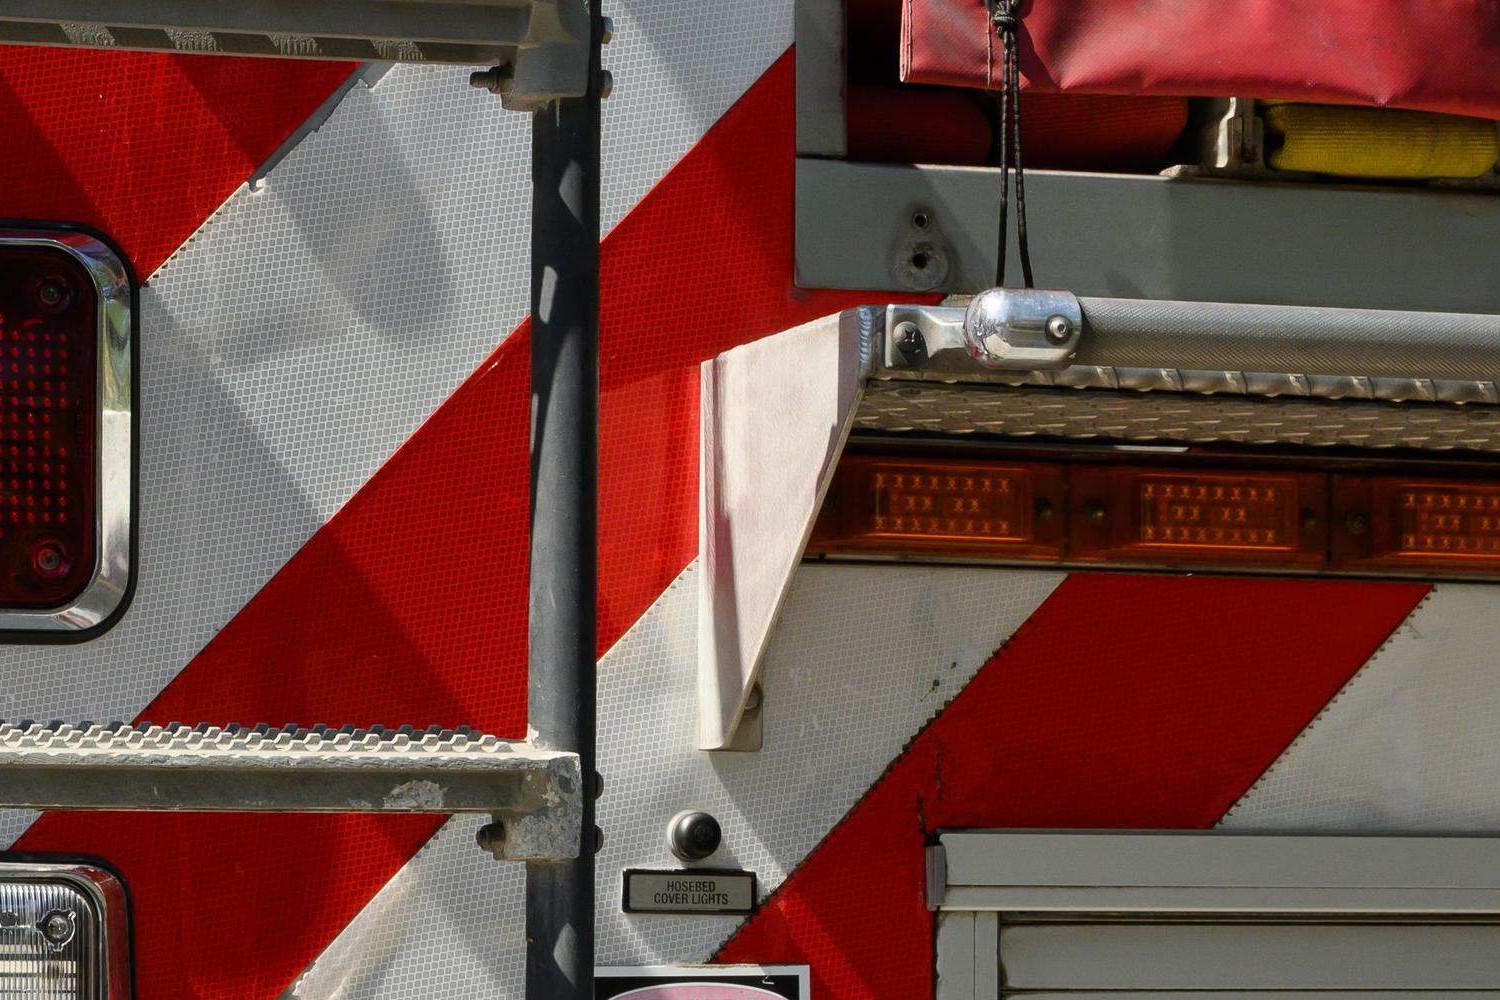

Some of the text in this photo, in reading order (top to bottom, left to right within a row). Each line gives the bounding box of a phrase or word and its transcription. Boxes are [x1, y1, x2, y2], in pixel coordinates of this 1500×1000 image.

[667, 881, 716, 892] HOSEBED
[653, 893, 729, 905] COVER LIGHTS
